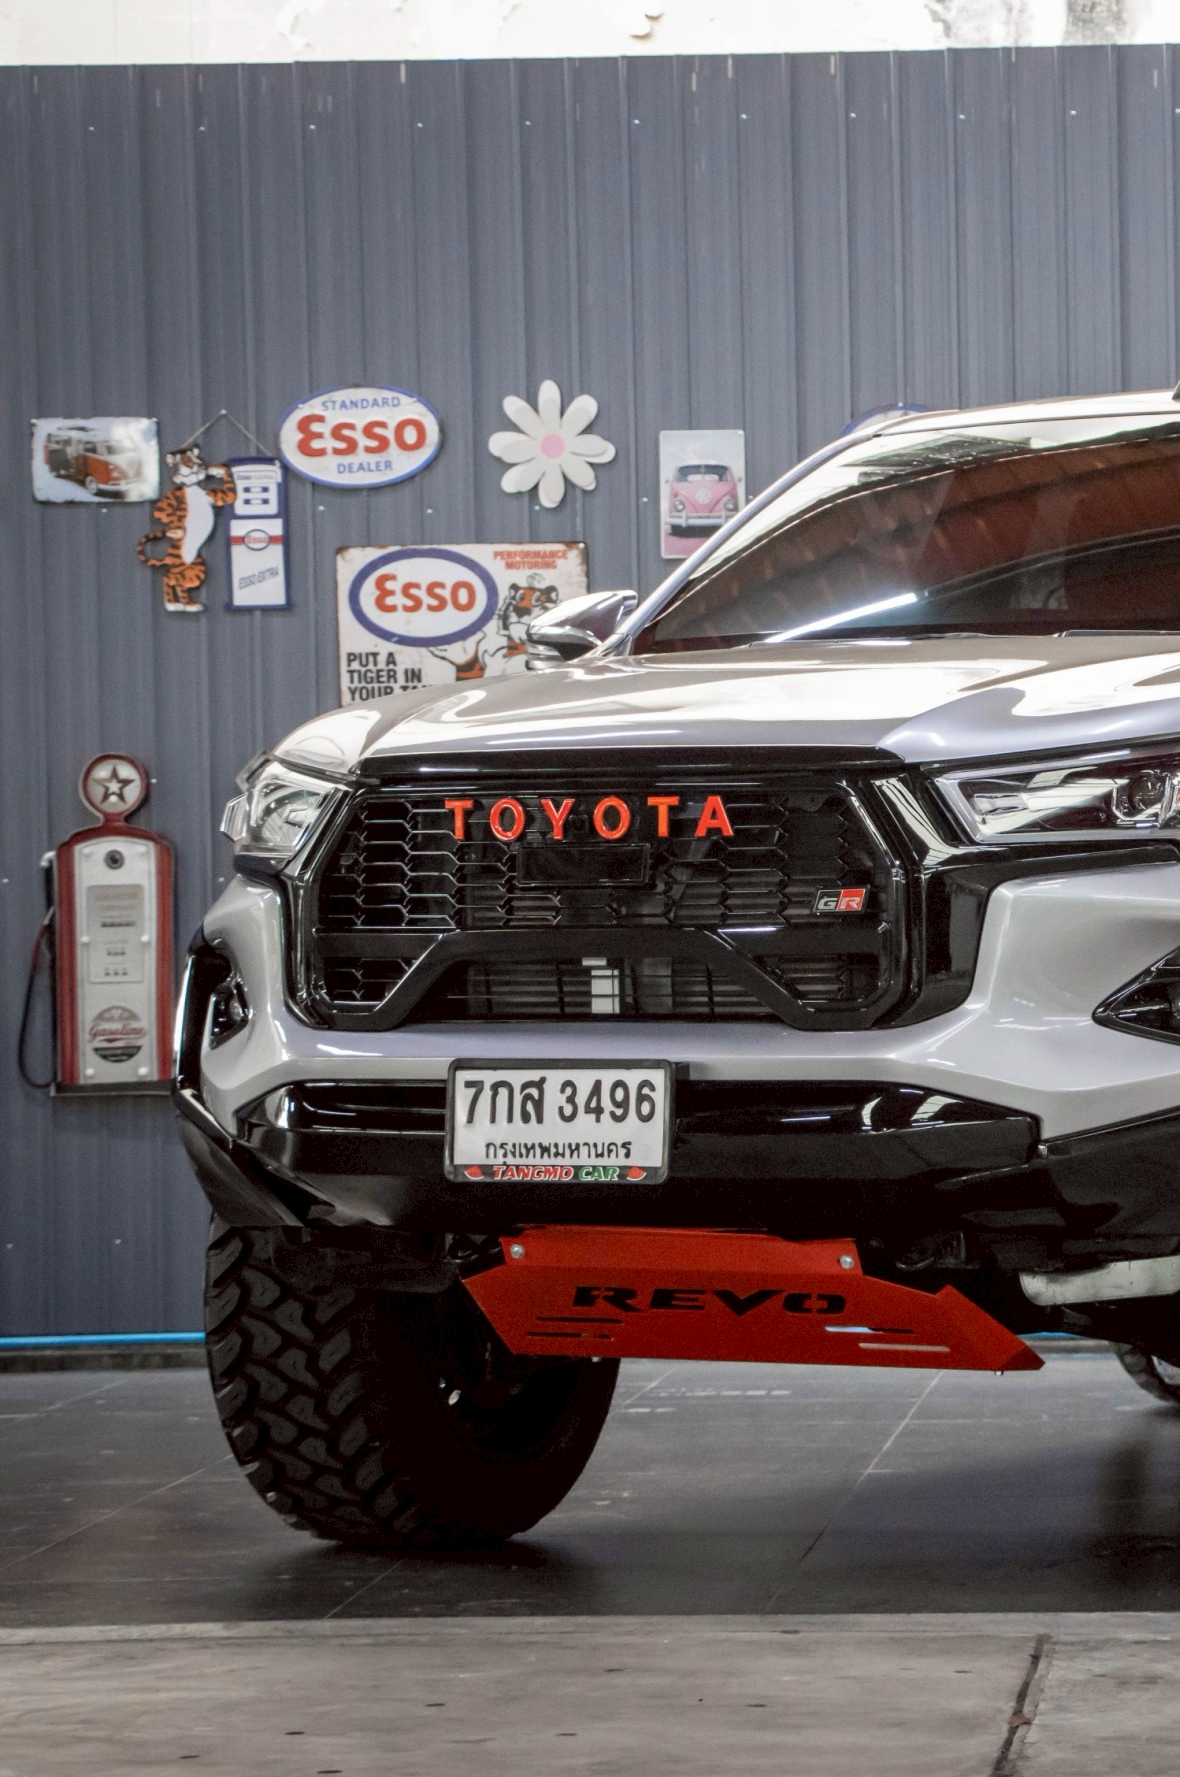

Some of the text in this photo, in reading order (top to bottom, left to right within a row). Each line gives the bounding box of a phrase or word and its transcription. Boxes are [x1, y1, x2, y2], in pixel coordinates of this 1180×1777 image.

[321, 396, 402, 412] STANDARD
[336, 460, 394, 474] DEALER
[493, 550, 569, 560] PERFORMANCE
[505, 560, 557, 570] MOTORING
[346, 652, 397, 667] PUT A
[346, 668, 422, 684] TIGER IN
[444, 795, 734, 841] TOYOTA
[817, 897, 860, 910] GR
[464, 1077, 657, 1124] 7กส 3496
[493, 1165, 619, 1181] TANGMO CAR
[572, 1285, 847, 1317] REVO
